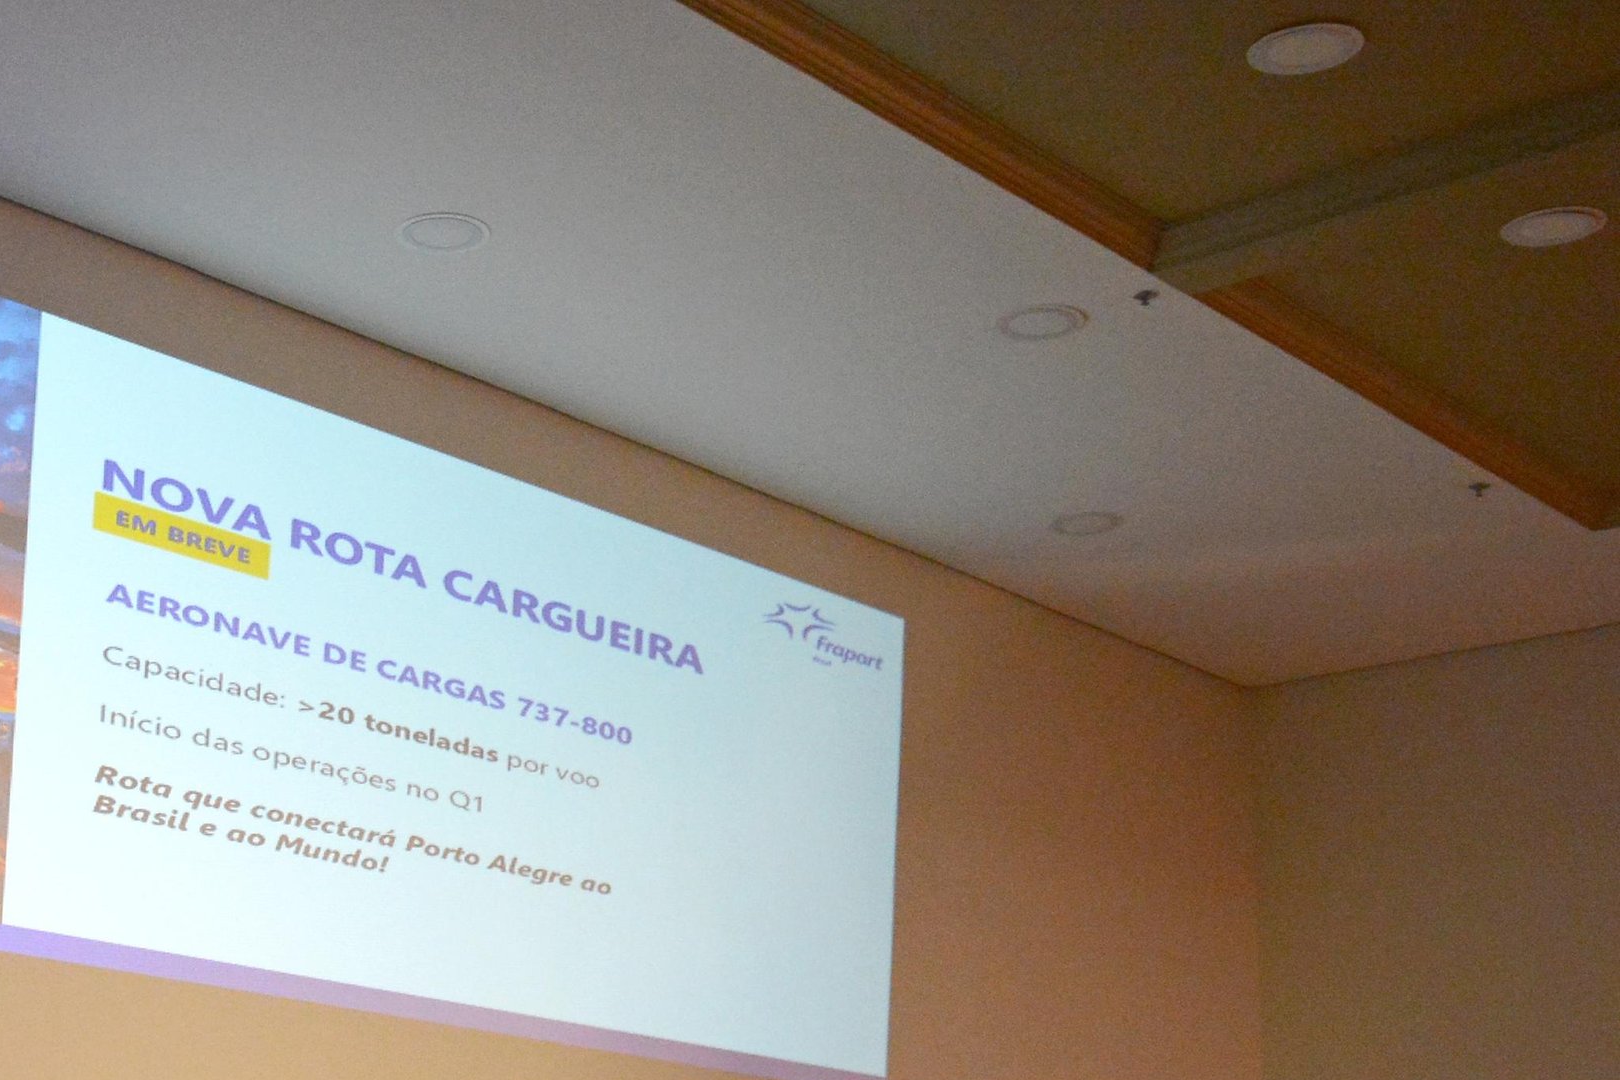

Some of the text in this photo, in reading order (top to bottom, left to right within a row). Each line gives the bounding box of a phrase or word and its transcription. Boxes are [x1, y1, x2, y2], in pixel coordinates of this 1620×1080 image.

[103, 459, 704, 675] NOVA ROTA CARGUEIRA
[116, 510, 250, 564] EM BREVE
[103, 646, 599, 788] Capacidade: >20 toneladas por voo
[106, 584, 633, 745] AERONAVE DE CARGAS 737-800
[100, 704, 482, 812] Início das operações no Q1
[93, 794, 390, 873] Brasil e ao Mundo!
[94, 765, 611, 895] Rota que conectará Porto Alegre ao
